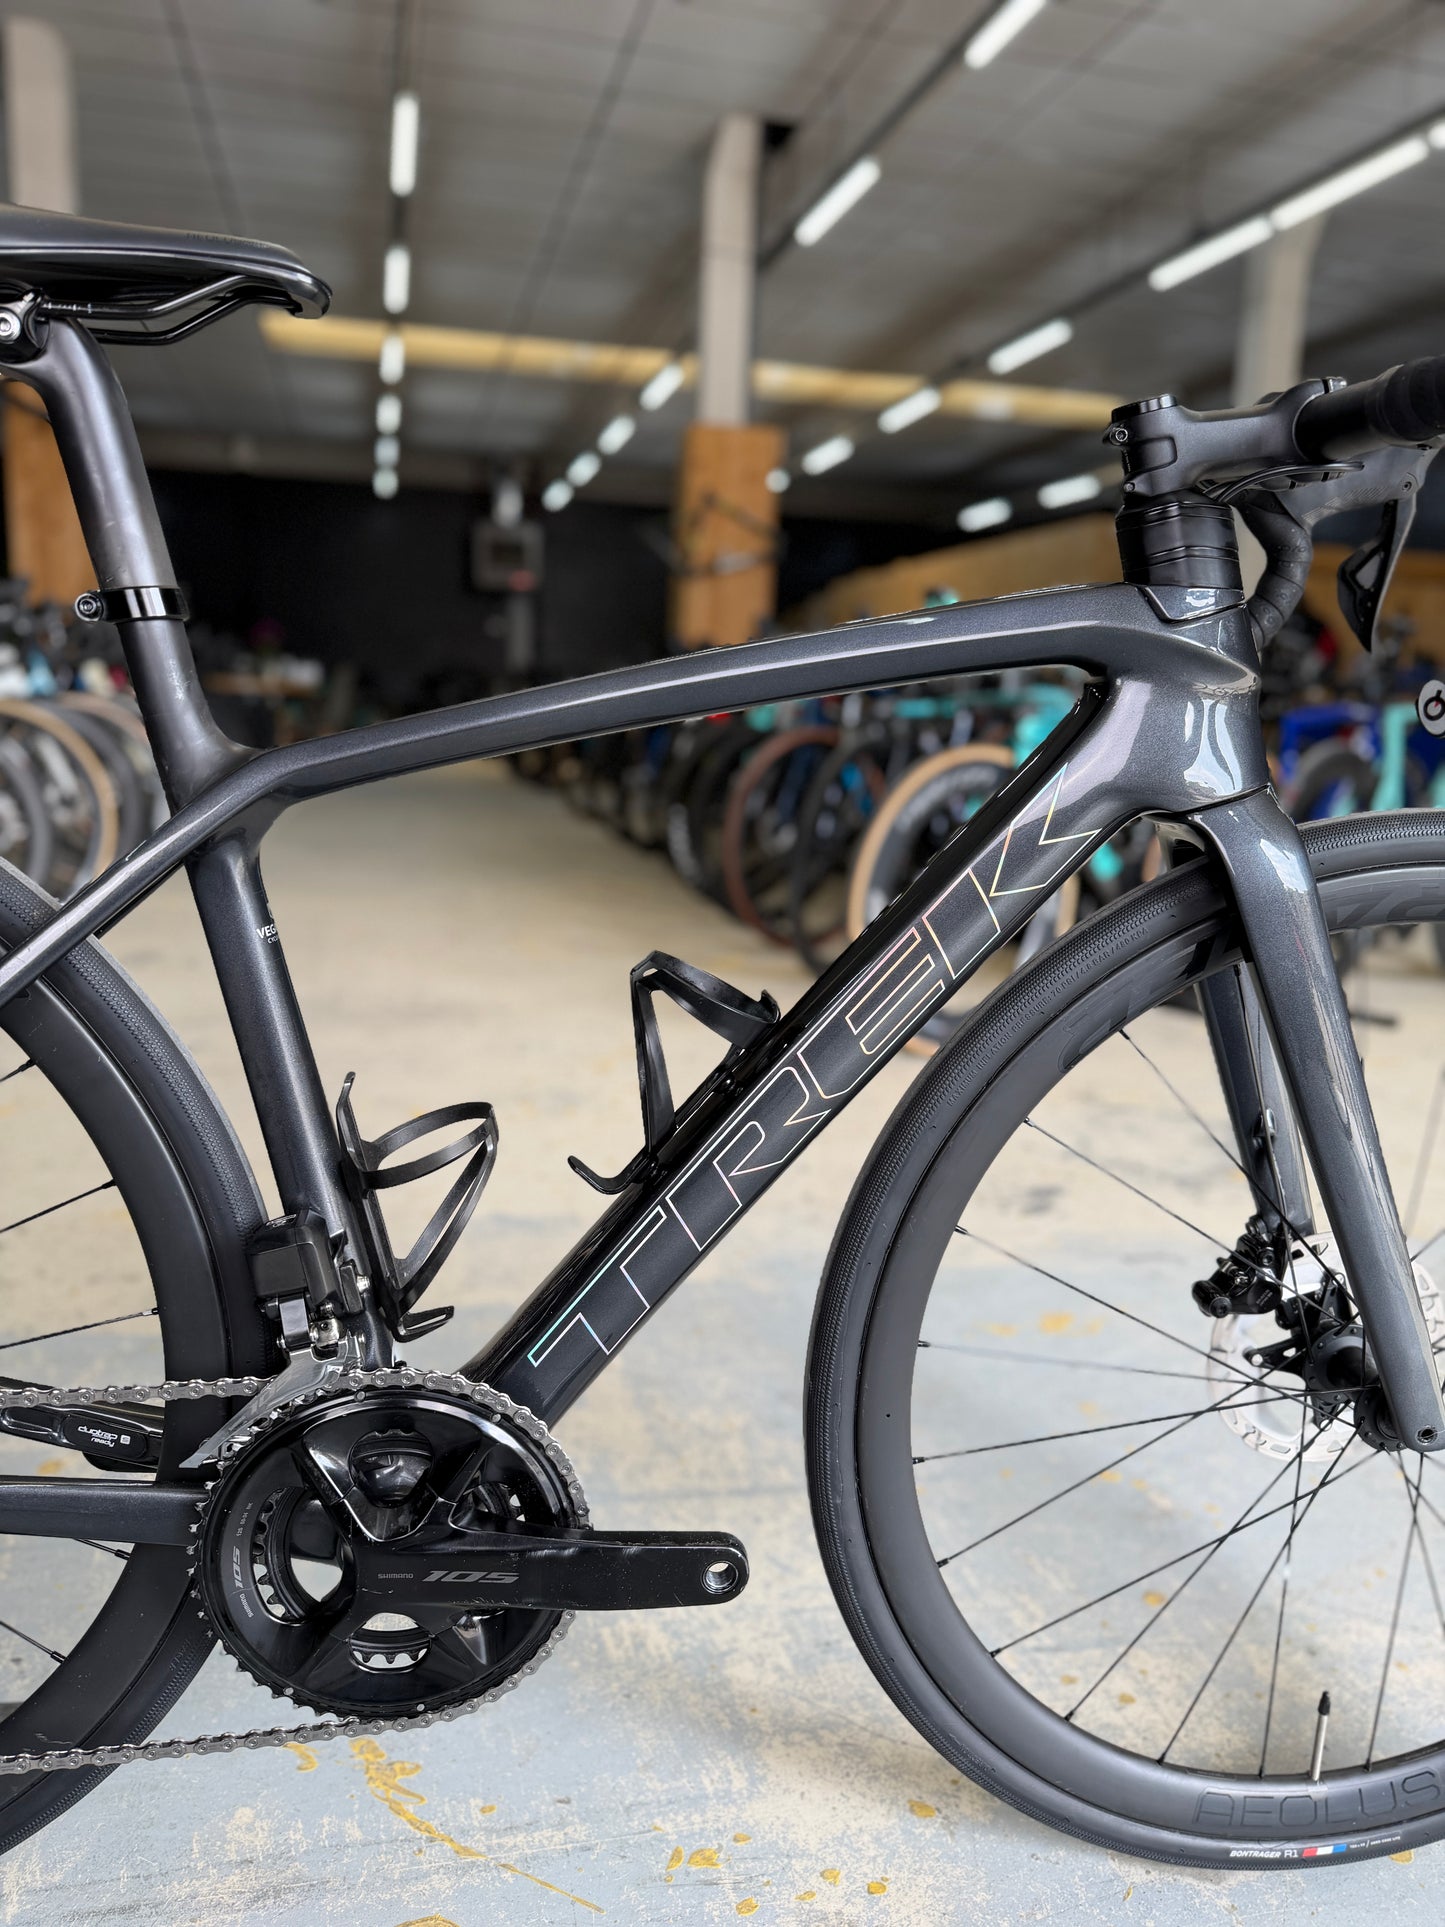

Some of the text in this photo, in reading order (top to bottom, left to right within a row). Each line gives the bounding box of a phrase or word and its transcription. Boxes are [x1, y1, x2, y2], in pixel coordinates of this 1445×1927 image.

[526, 763, 1102, 1367] TREK
[946, 1069, 977, 1107] MAXIMUM
[976, 1031, 1013, 1070] INFLATION
[77, 1425, 119, 1441] duotrap
[90, 1437, 115, 1448] ready
[232, 1545, 244, 1589] 105
[377, 1570, 520, 1584] SHIMANO 105
[1193, 1770, 1441, 1827] AEOLUS
[1229, 1849, 1299, 1859] BONTRAGER R1
